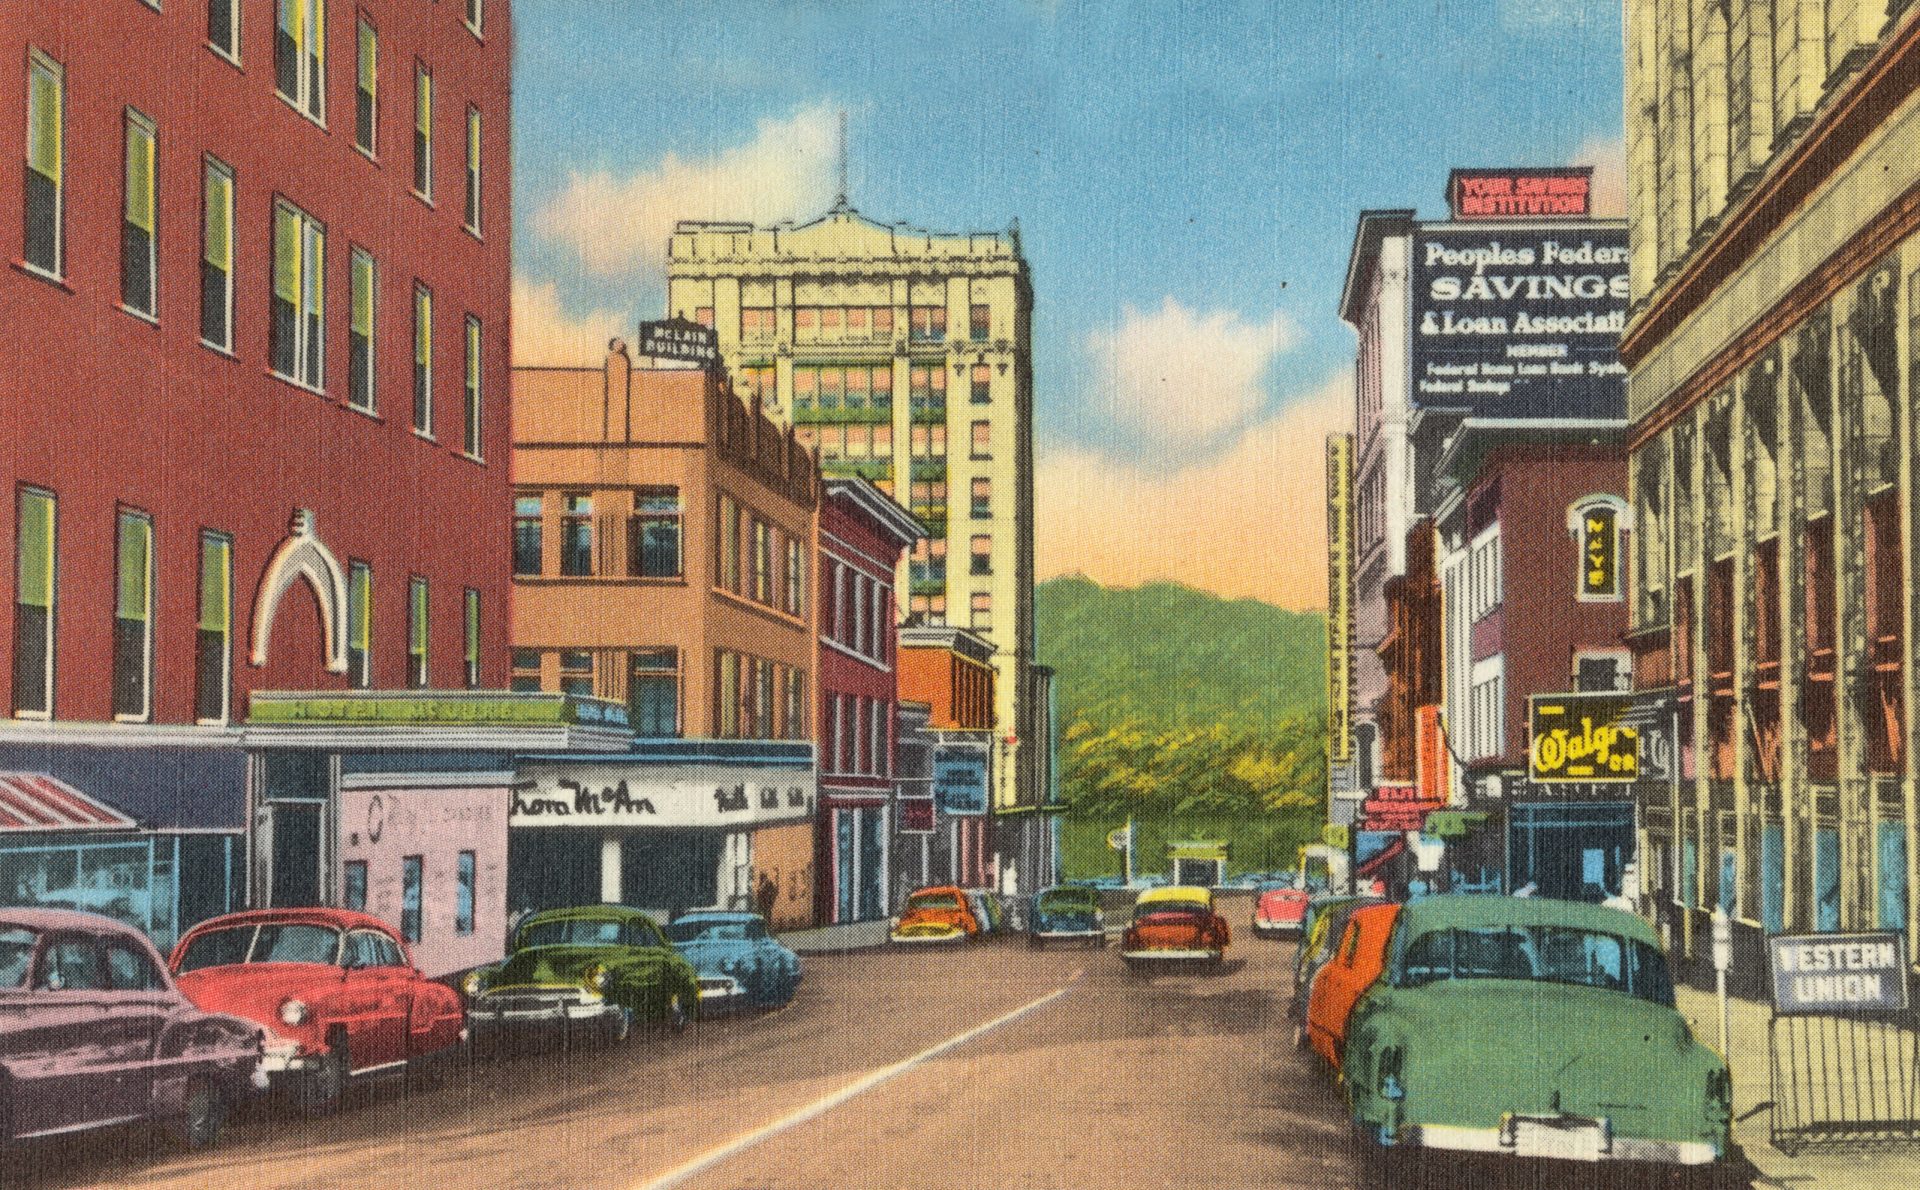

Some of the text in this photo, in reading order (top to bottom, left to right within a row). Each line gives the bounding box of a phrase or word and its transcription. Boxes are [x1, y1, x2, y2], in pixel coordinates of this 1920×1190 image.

[1461, 176, 1588, 196] YOUR SAVINGS
[1462, 195, 1585, 214] INSTITUTION
[1425, 241, 1536, 275] Peoples
[1430, 275, 1629, 301] SAVINGS
[1420, 309, 1626, 335] & Loan Associati
[645, 338, 716, 360] BUILDING
[1426, 361, 1478, 376] Federal
[1779, 942, 1895, 972] WESTERN
[1794, 973, 1882, 1003] UNION
